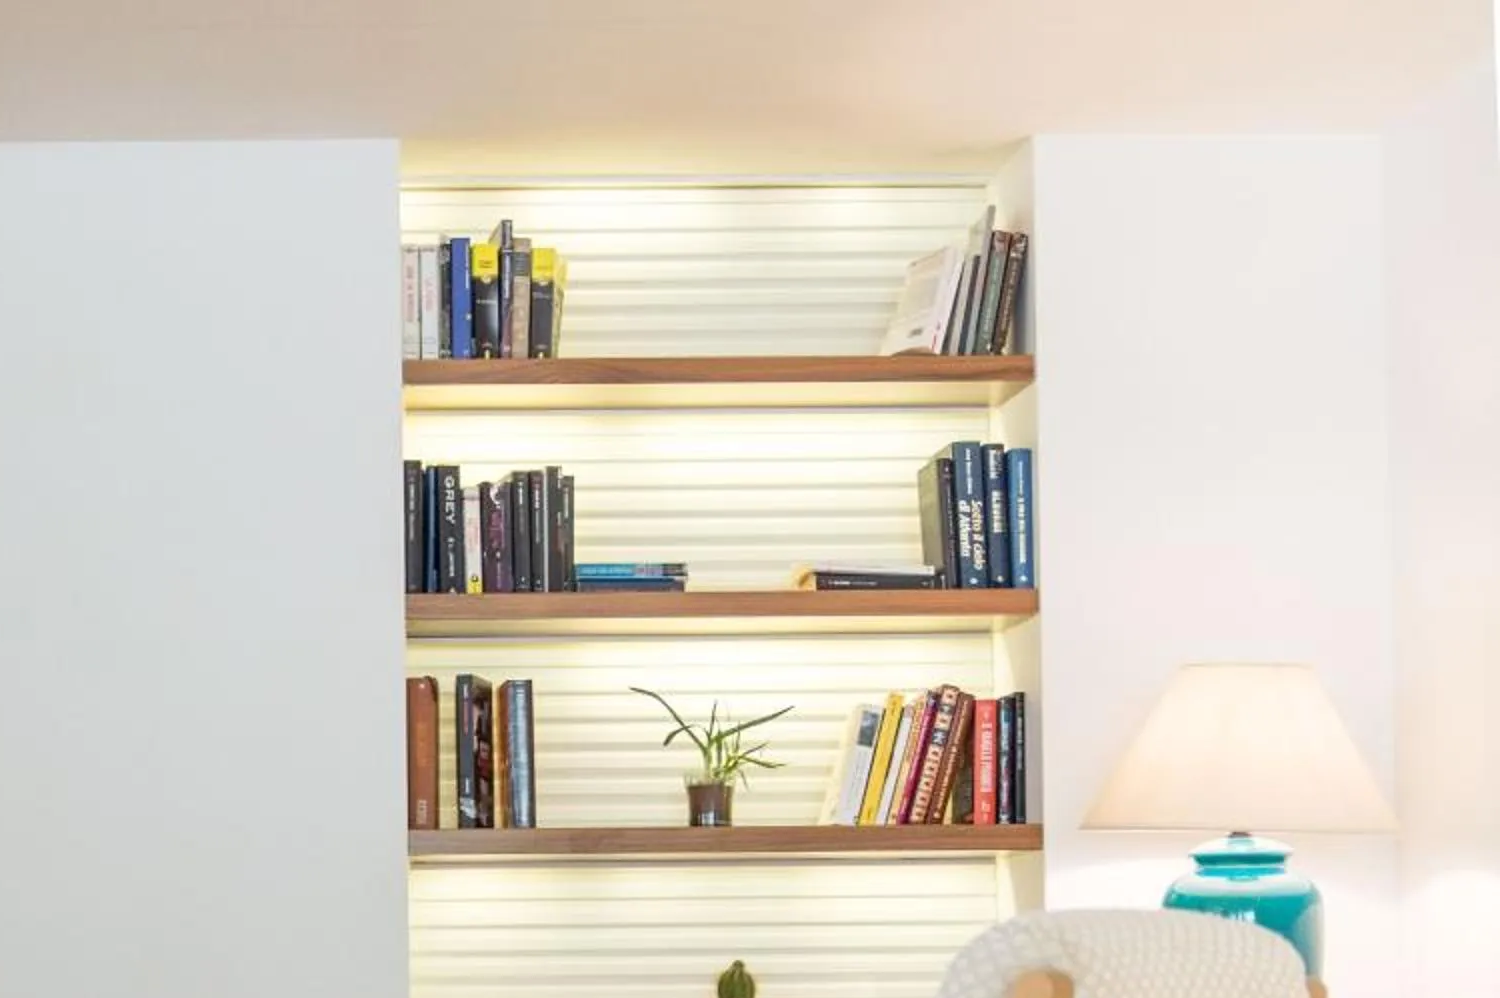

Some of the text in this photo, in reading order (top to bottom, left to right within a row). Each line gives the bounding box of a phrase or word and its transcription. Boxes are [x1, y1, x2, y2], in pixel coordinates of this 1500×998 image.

[444, 475, 455, 525] GREY
[972, 499, 983, 531] Sotto
[959, 514, 971, 557] Atlanta
[973, 543, 985, 571] cielo
